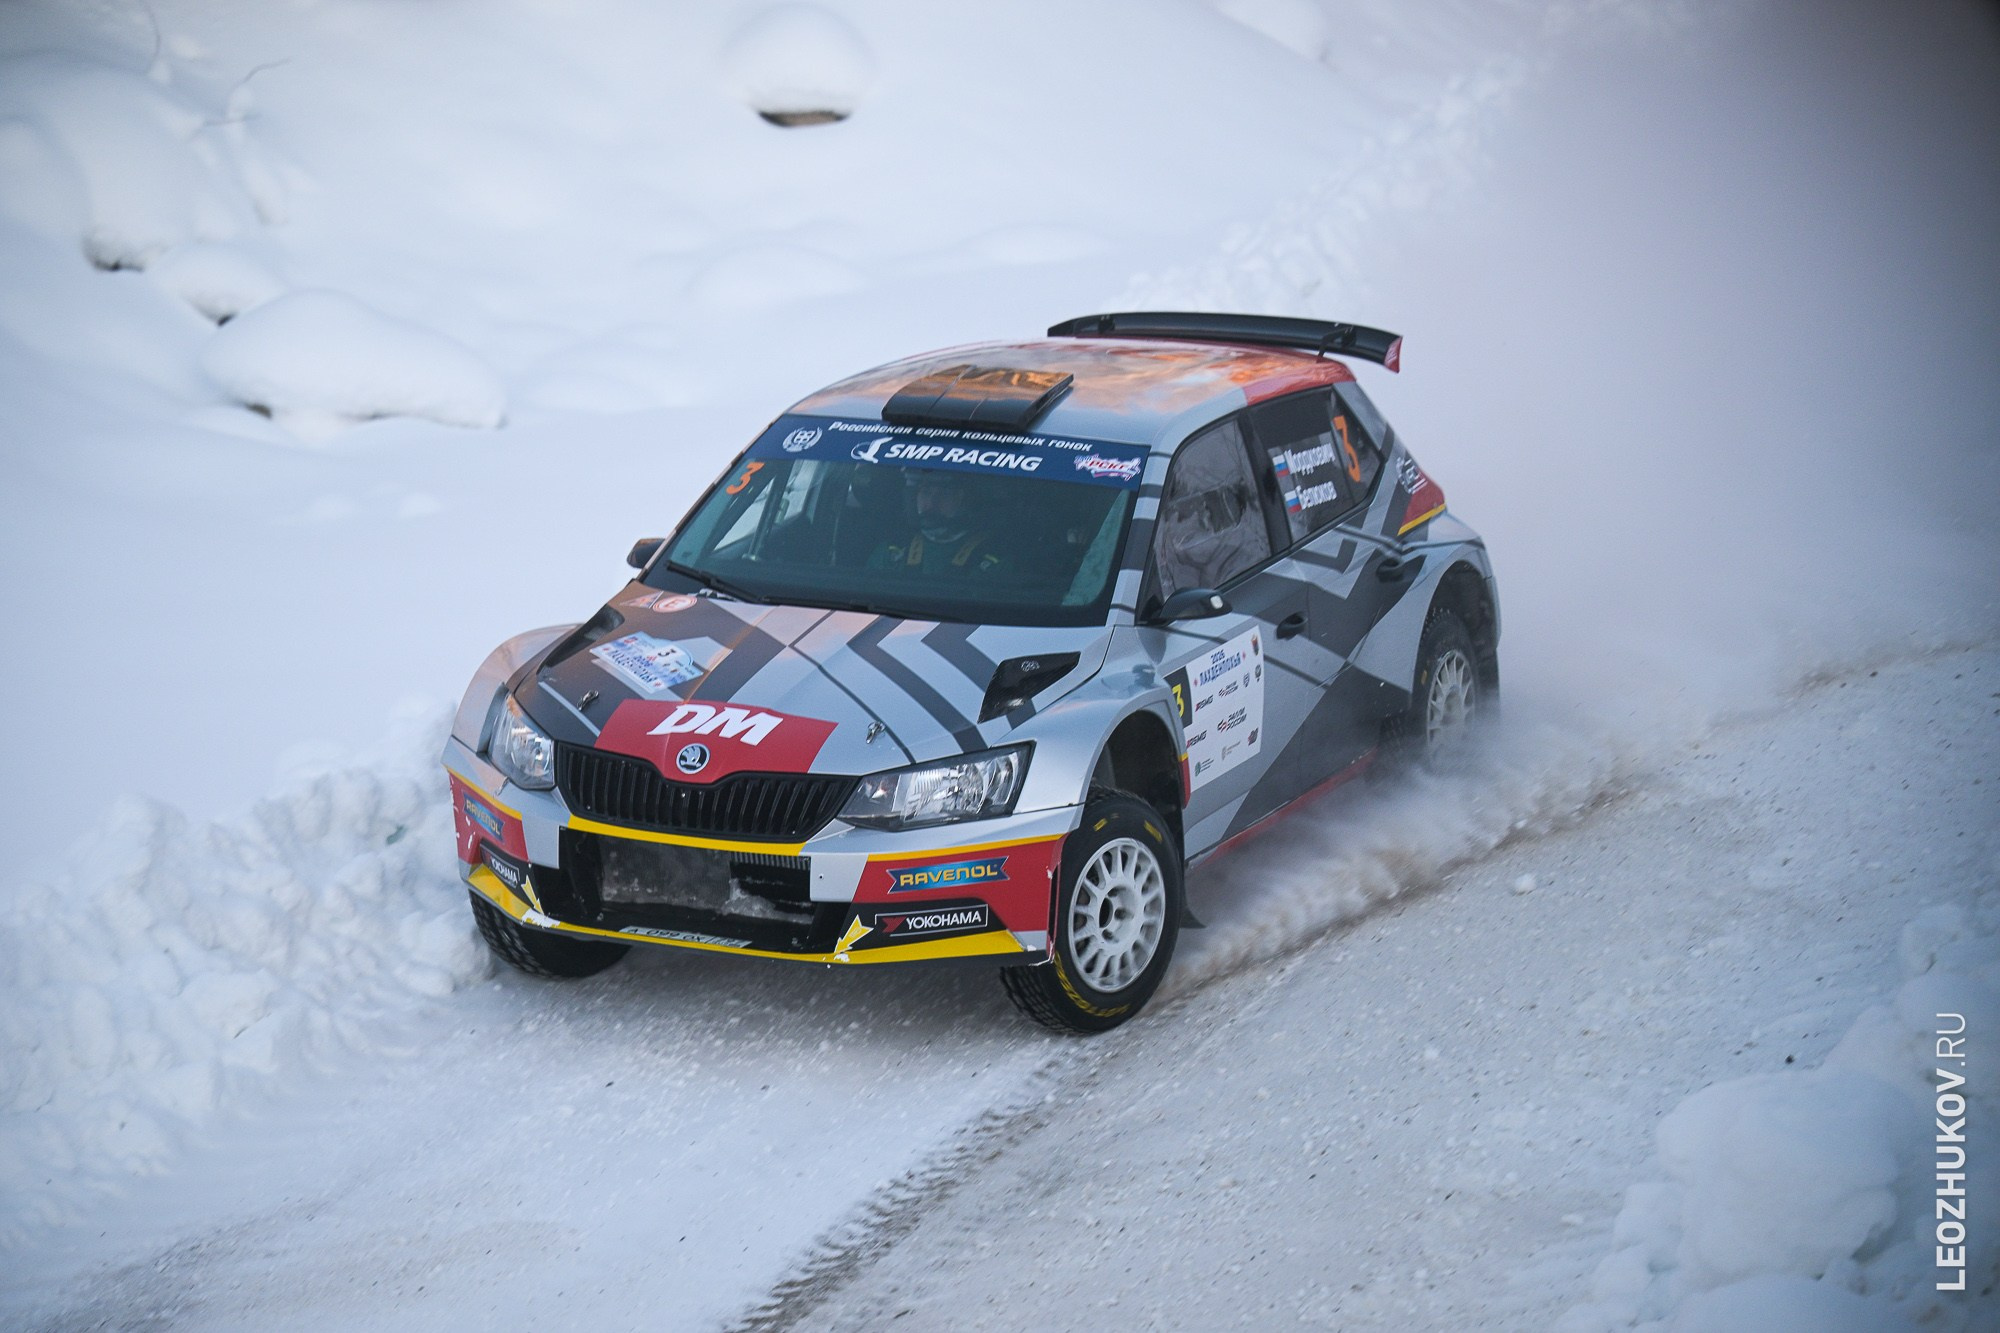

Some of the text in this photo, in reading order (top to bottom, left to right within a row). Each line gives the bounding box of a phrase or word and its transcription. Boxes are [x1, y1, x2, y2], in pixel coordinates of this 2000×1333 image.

[828, 421, 1094, 452] Российская серия кольцевых гонок
[1333, 415, 1360, 483] 3
[884, 443, 1043, 472] SMP RACING
[725, 462, 764, 495] 3
[1172, 684, 1184, 718] 3
[646, 703, 783, 746] DM
[466, 799, 501, 836] RAVENOL
[491, 858, 519, 885] YOKOHAMA
[899, 864, 998, 888] RAVENOL
[906, 910, 982, 931] YOKOHAMA
